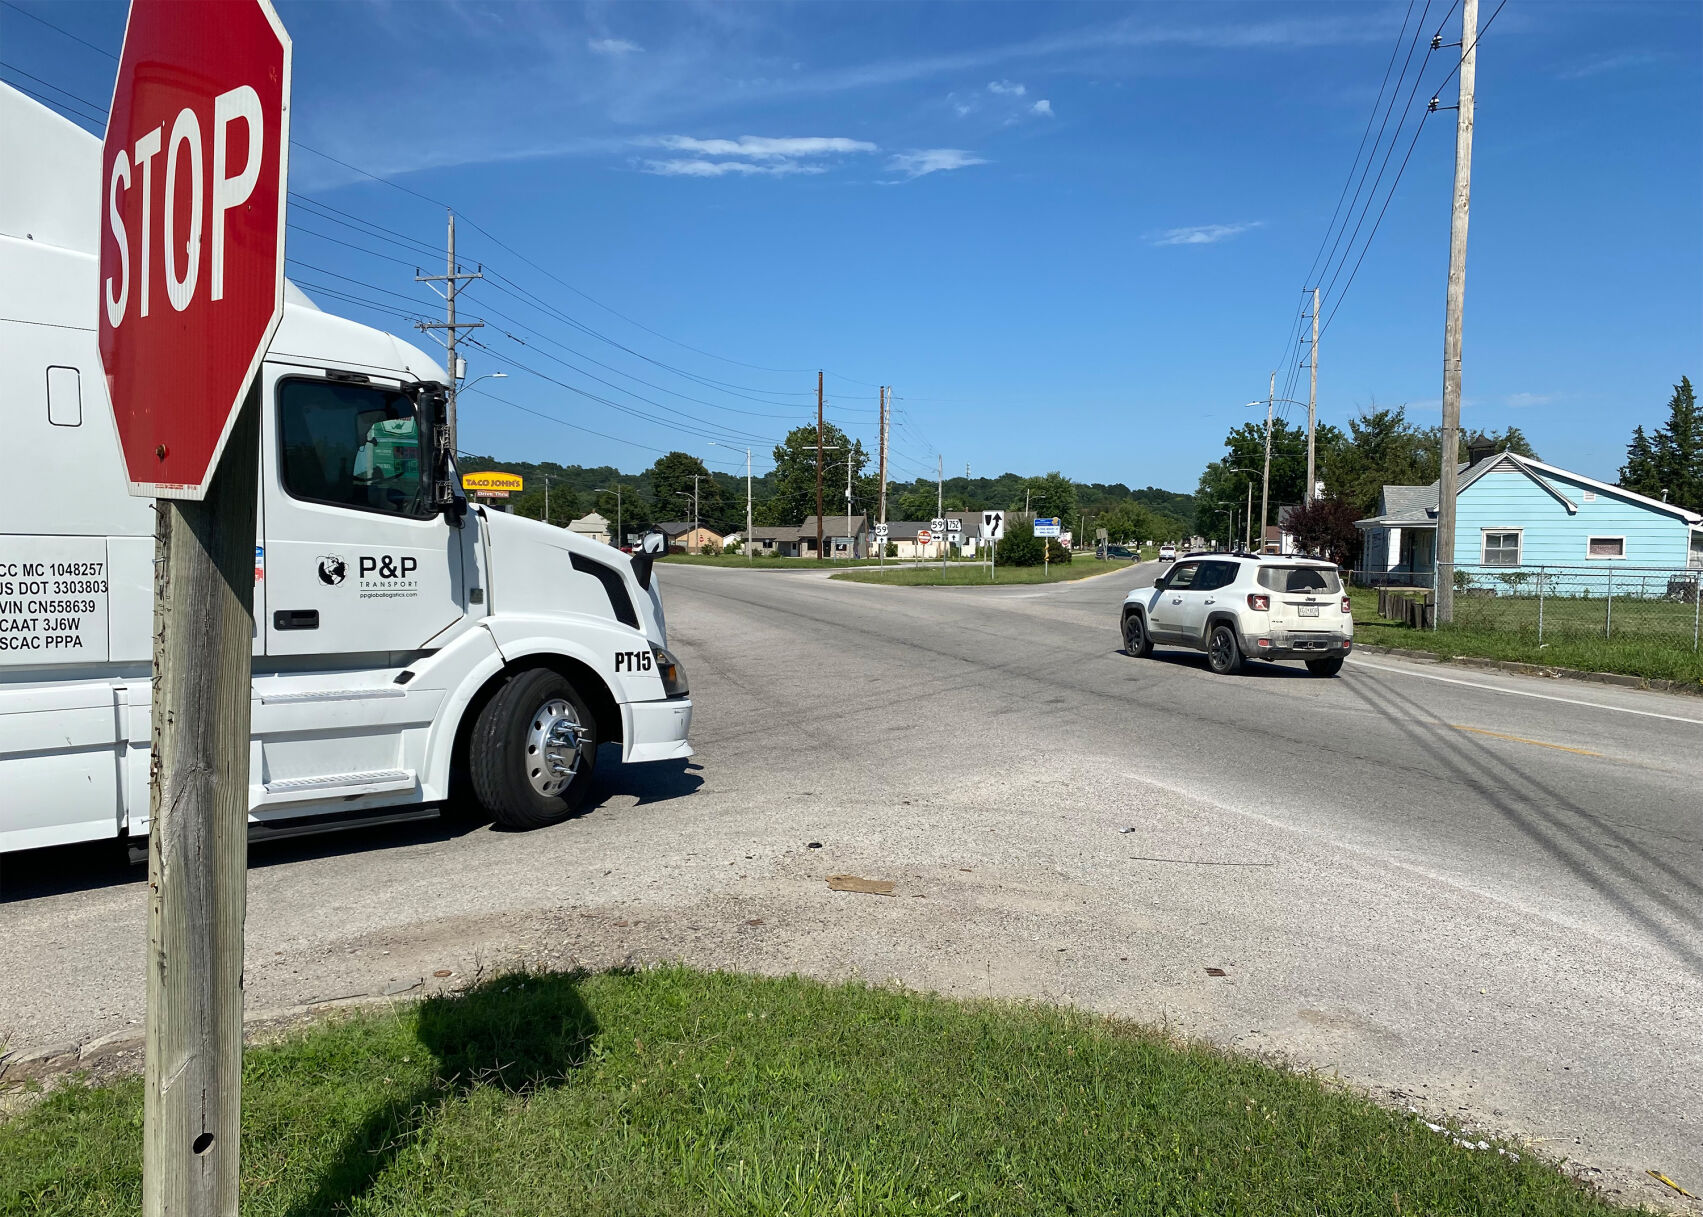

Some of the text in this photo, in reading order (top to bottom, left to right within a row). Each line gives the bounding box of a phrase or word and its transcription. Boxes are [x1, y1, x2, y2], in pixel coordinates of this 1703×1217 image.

[106, 85, 264, 328] STOP
[932, 521, 943, 529] 59
[949, 520, 959, 528] 752
[22, 563, 45, 577] MC
[50, 562, 104, 577] 1048257
[359, 555, 417, 579] P&P
[19, 581, 49, 595] DOT
[53, 580, 108, 594] 3303803
[0, 599, 96, 614] VIN CN558639
[0, 617, 81, 632] CAAT 3J6W
[0, 635, 83, 650] SCAC PPPA
[615, 651, 652, 672] PT15
